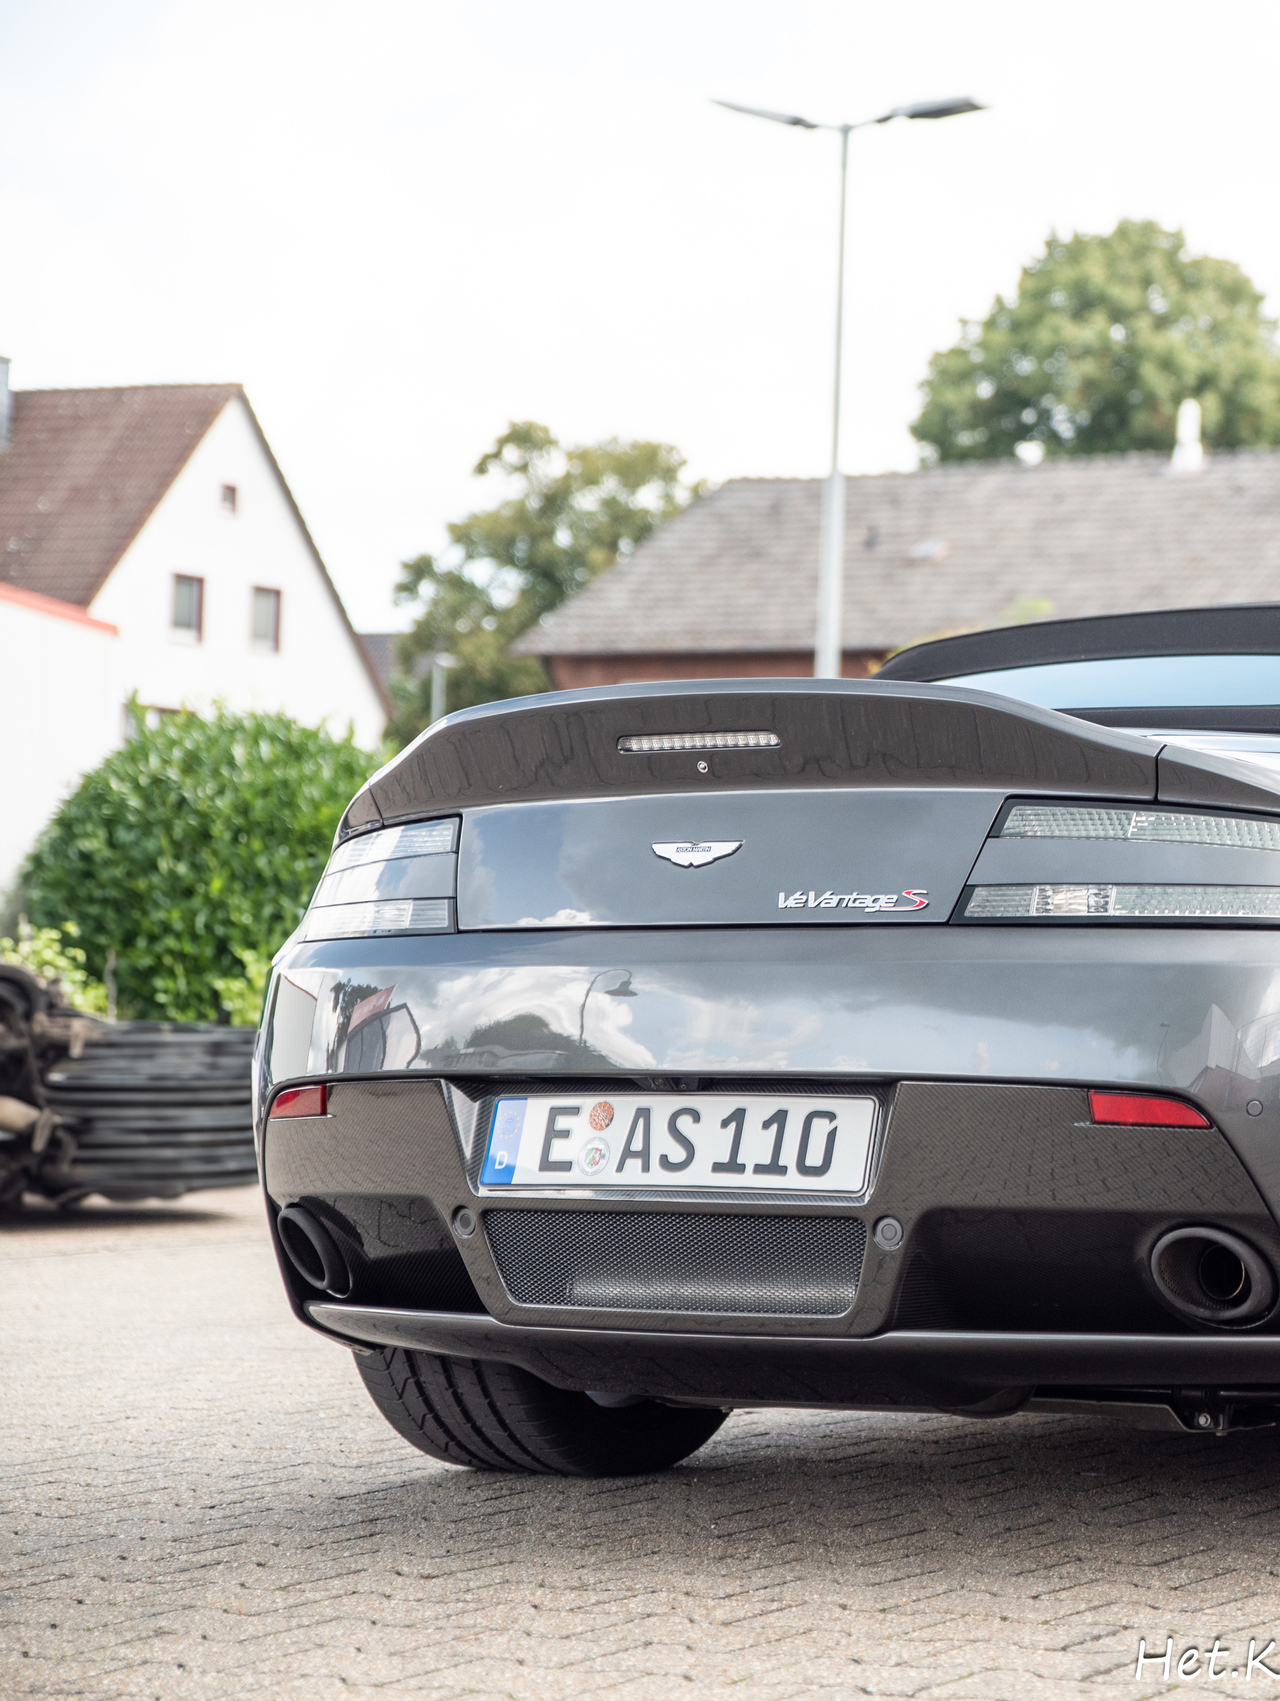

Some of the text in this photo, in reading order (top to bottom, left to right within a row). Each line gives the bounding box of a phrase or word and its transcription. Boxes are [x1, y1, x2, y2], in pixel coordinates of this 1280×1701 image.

[892, 889, 930, 912] S
[538, 1106, 838, 1178] E AS 110
[494, 1150, 508, 1170] D
